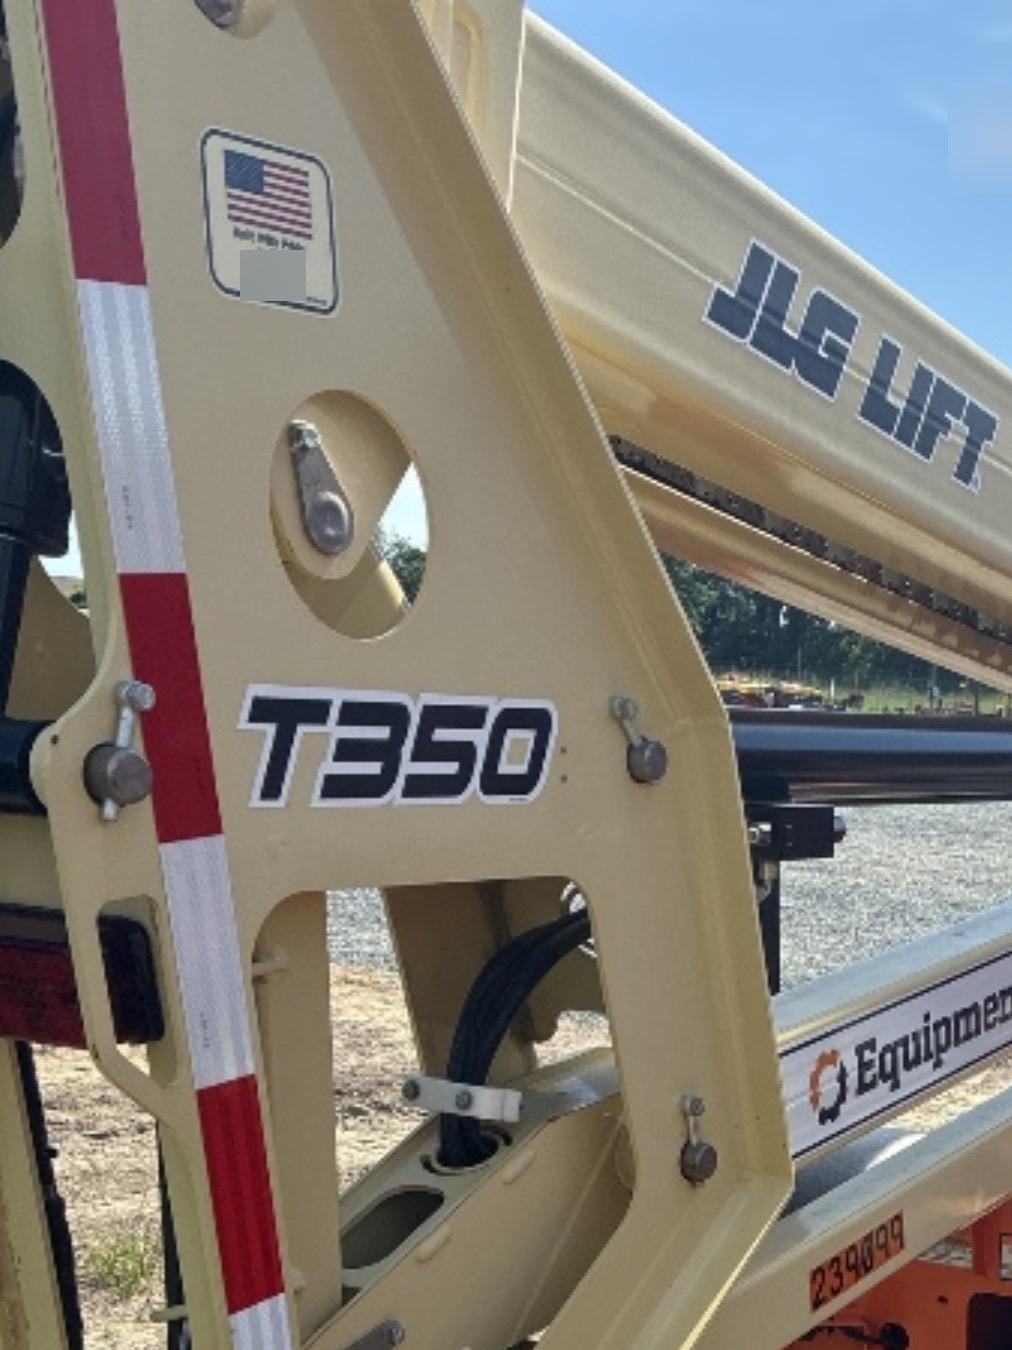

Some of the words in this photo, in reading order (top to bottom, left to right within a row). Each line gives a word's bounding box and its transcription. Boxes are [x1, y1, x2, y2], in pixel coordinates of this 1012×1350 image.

[703, 239, 862, 402] JLG
[857, 333, 999, 495] LIFT
[237, 683, 557, 808] T350
